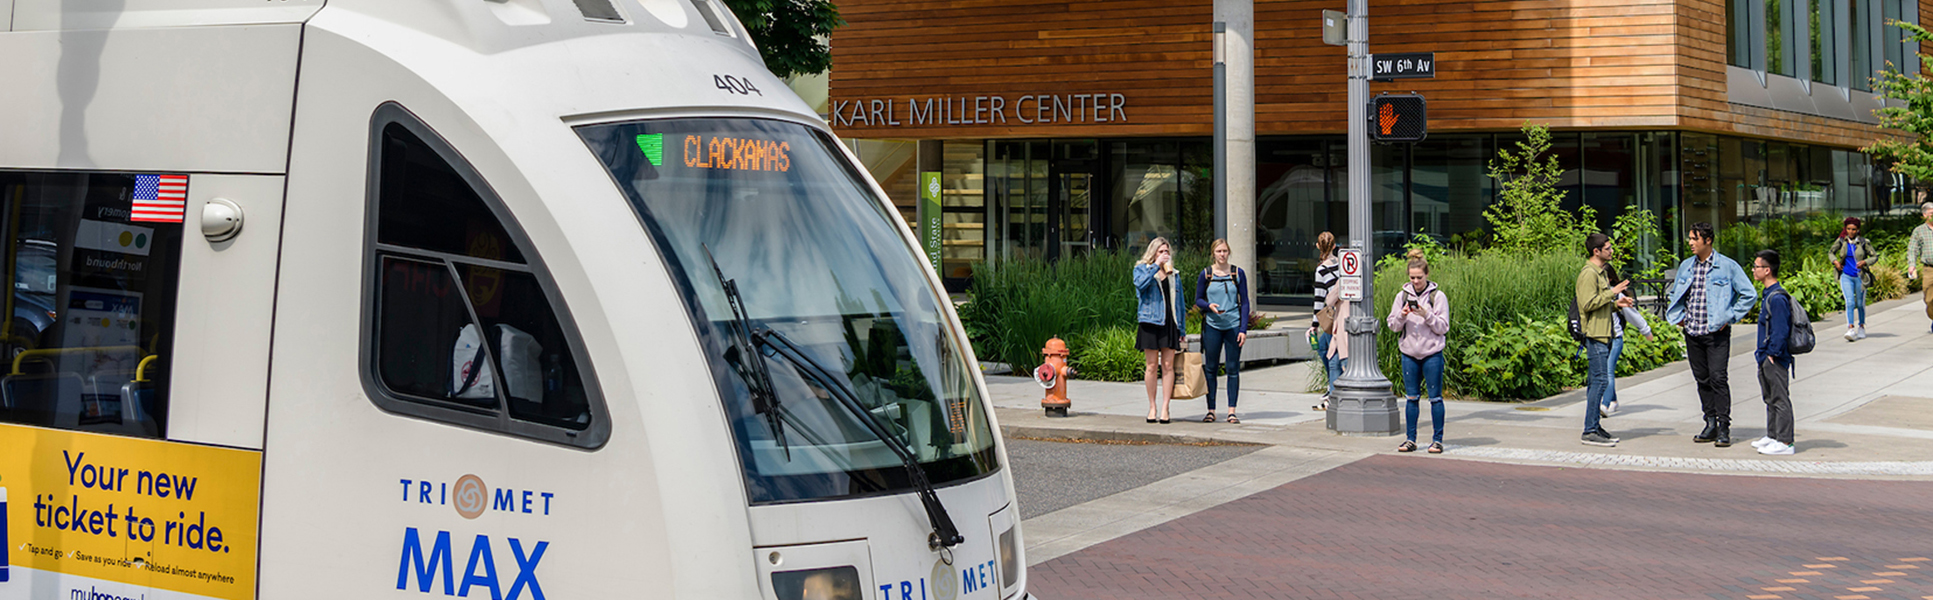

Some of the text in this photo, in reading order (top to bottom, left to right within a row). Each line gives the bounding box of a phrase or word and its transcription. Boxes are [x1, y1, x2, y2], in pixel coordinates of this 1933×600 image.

[1376, 58, 1430, 73] SW 6th Av
[713, 74, 762, 97] 404
[833, 93, 1127, 126] KARL MILLER CENTER
[683, 134, 790, 172] CLACKAMAS
[930, 217, 938, 249] State
[63, 450, 197, 501] Your new
[400, 479, 554, 515] TRI MET
[34, 494, 230, 553] ticket to ride.
[27, 543, 63, 560] Tap and go
[76, 550, 93, 562] Save
[103, 557, 115, 567] you
[117, 558, 131, 568] ride
[396, 527, 550, 600] MAX
[145, 560, 235, 584] Reload almost anywhere
[879, 560, 995, 600] TRI MET
